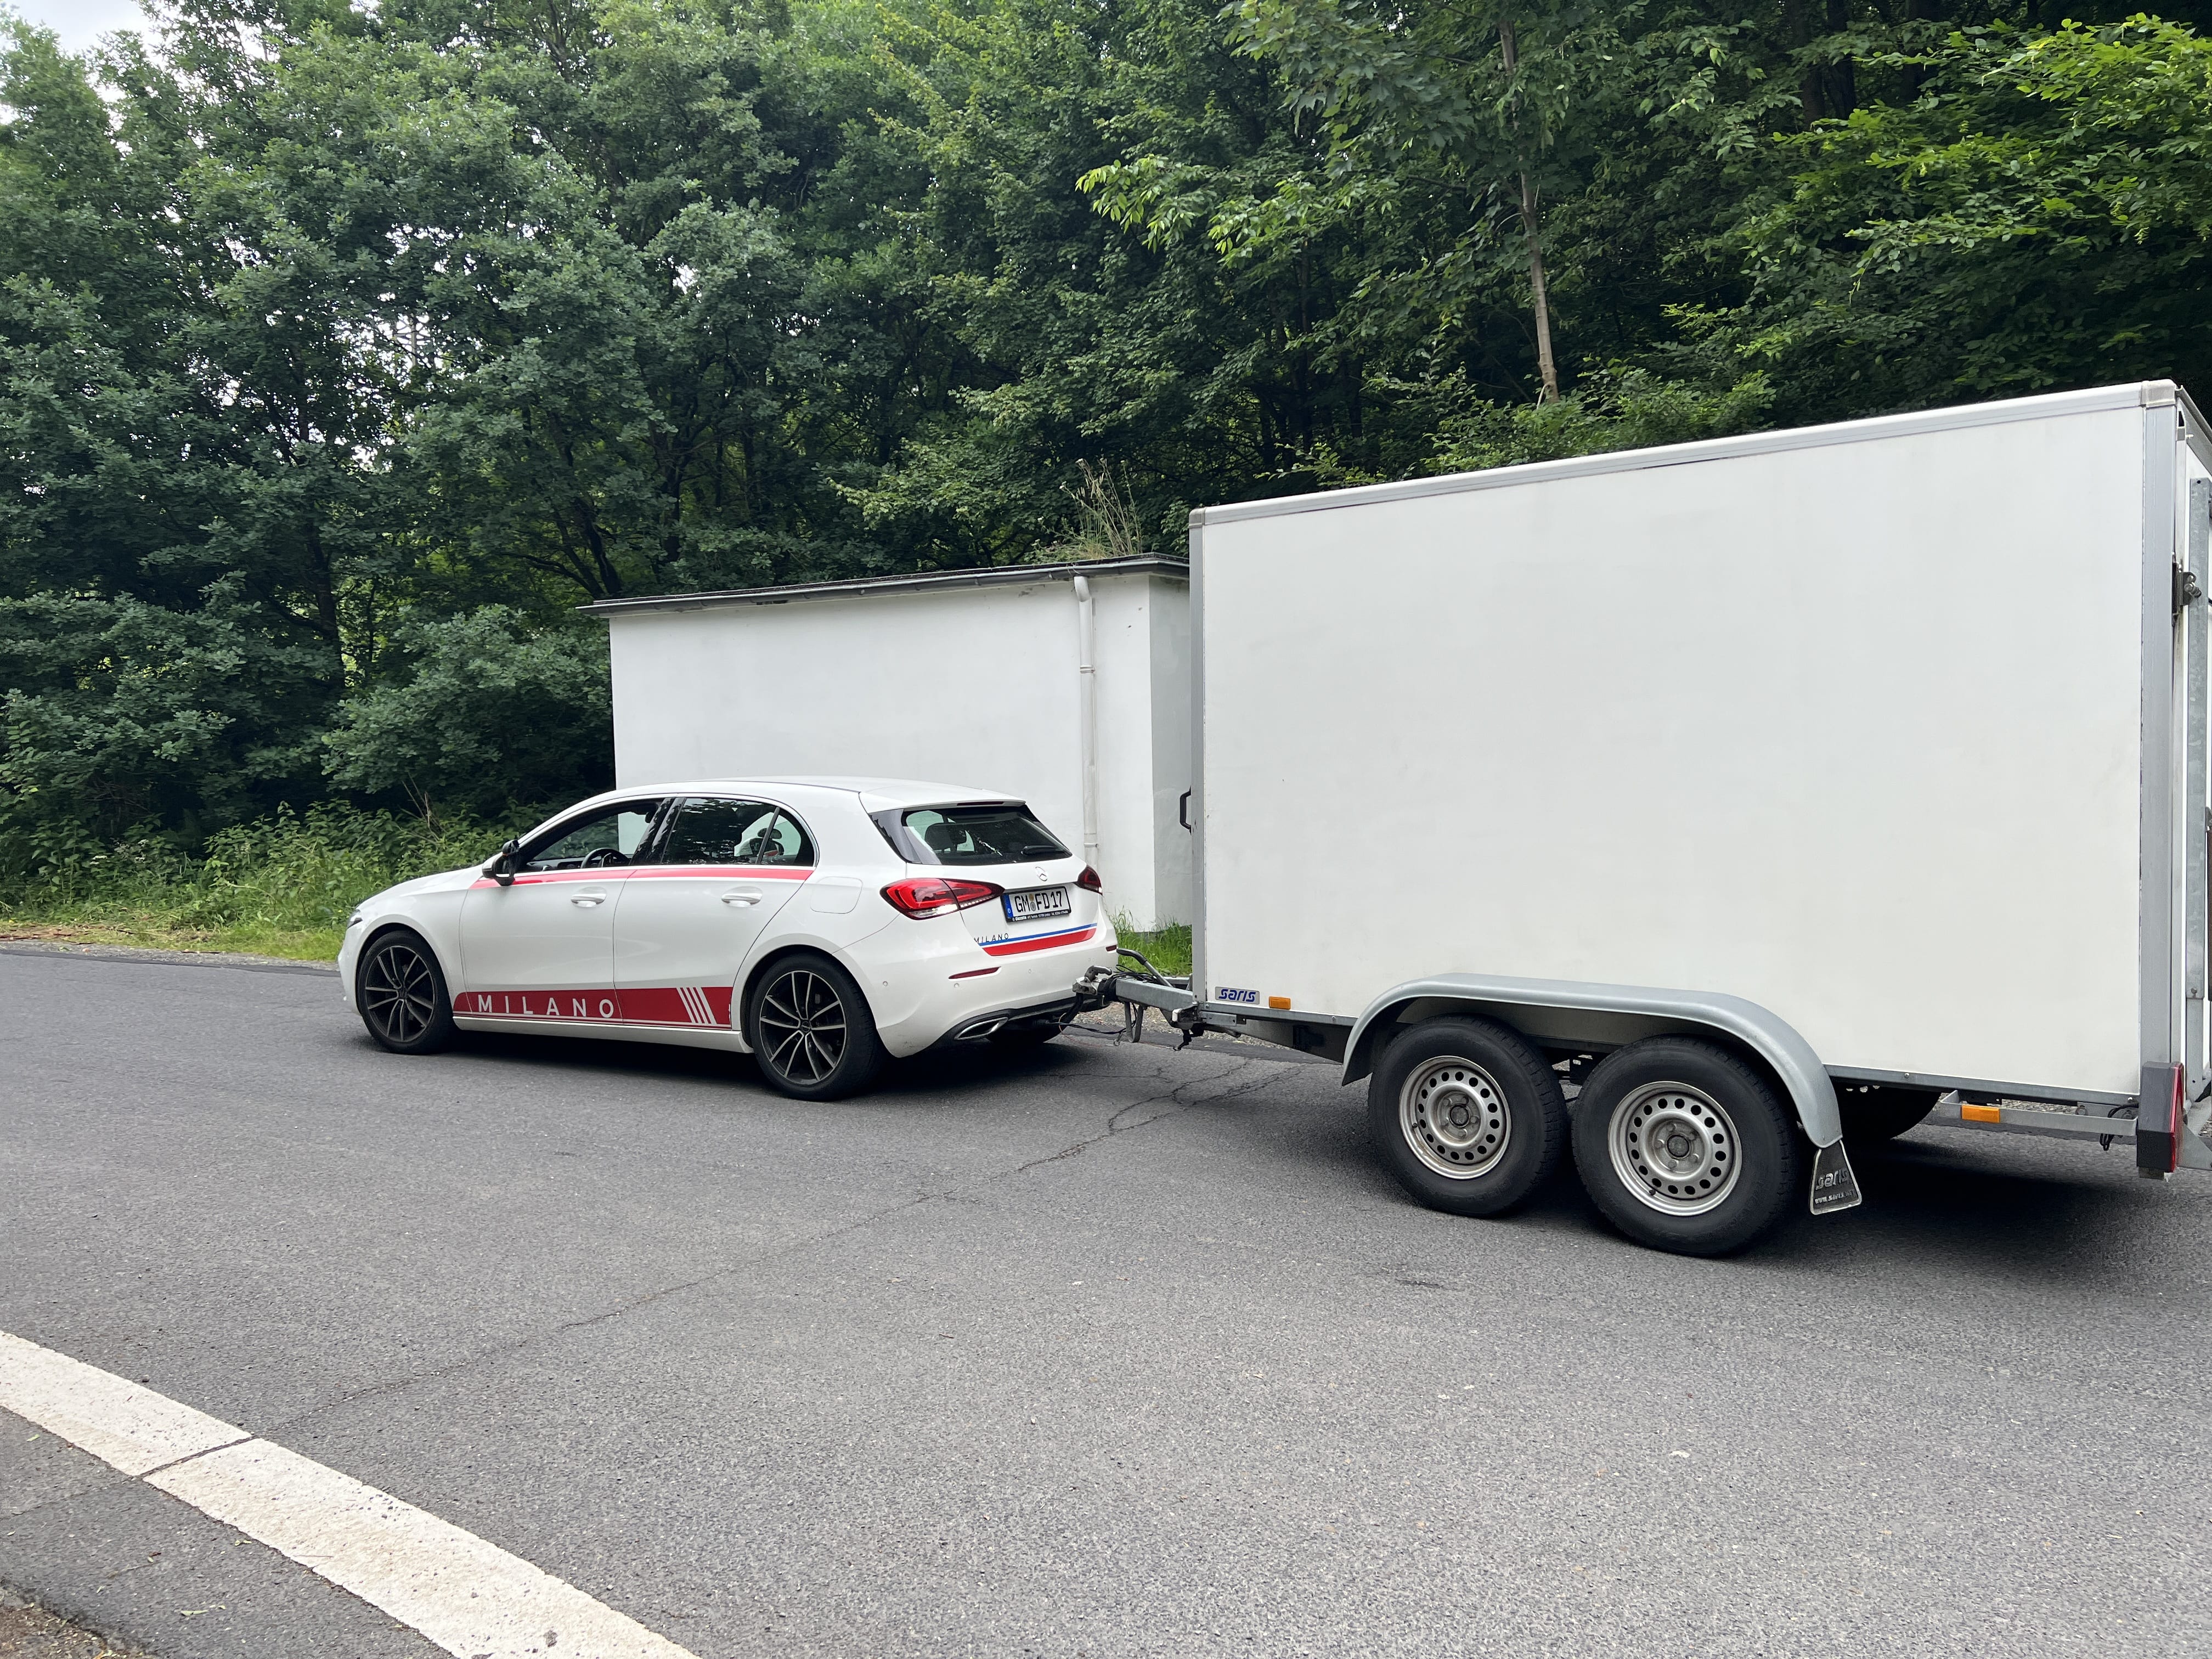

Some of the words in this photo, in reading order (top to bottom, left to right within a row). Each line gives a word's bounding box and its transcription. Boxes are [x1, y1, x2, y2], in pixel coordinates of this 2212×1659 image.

[1014, 895, 1031, 912] GM
[974, 933, 1009, 944] MILANO
[1218, 989, 1256, 1002] saris
[478, 994, 614, 1018] MILANO
